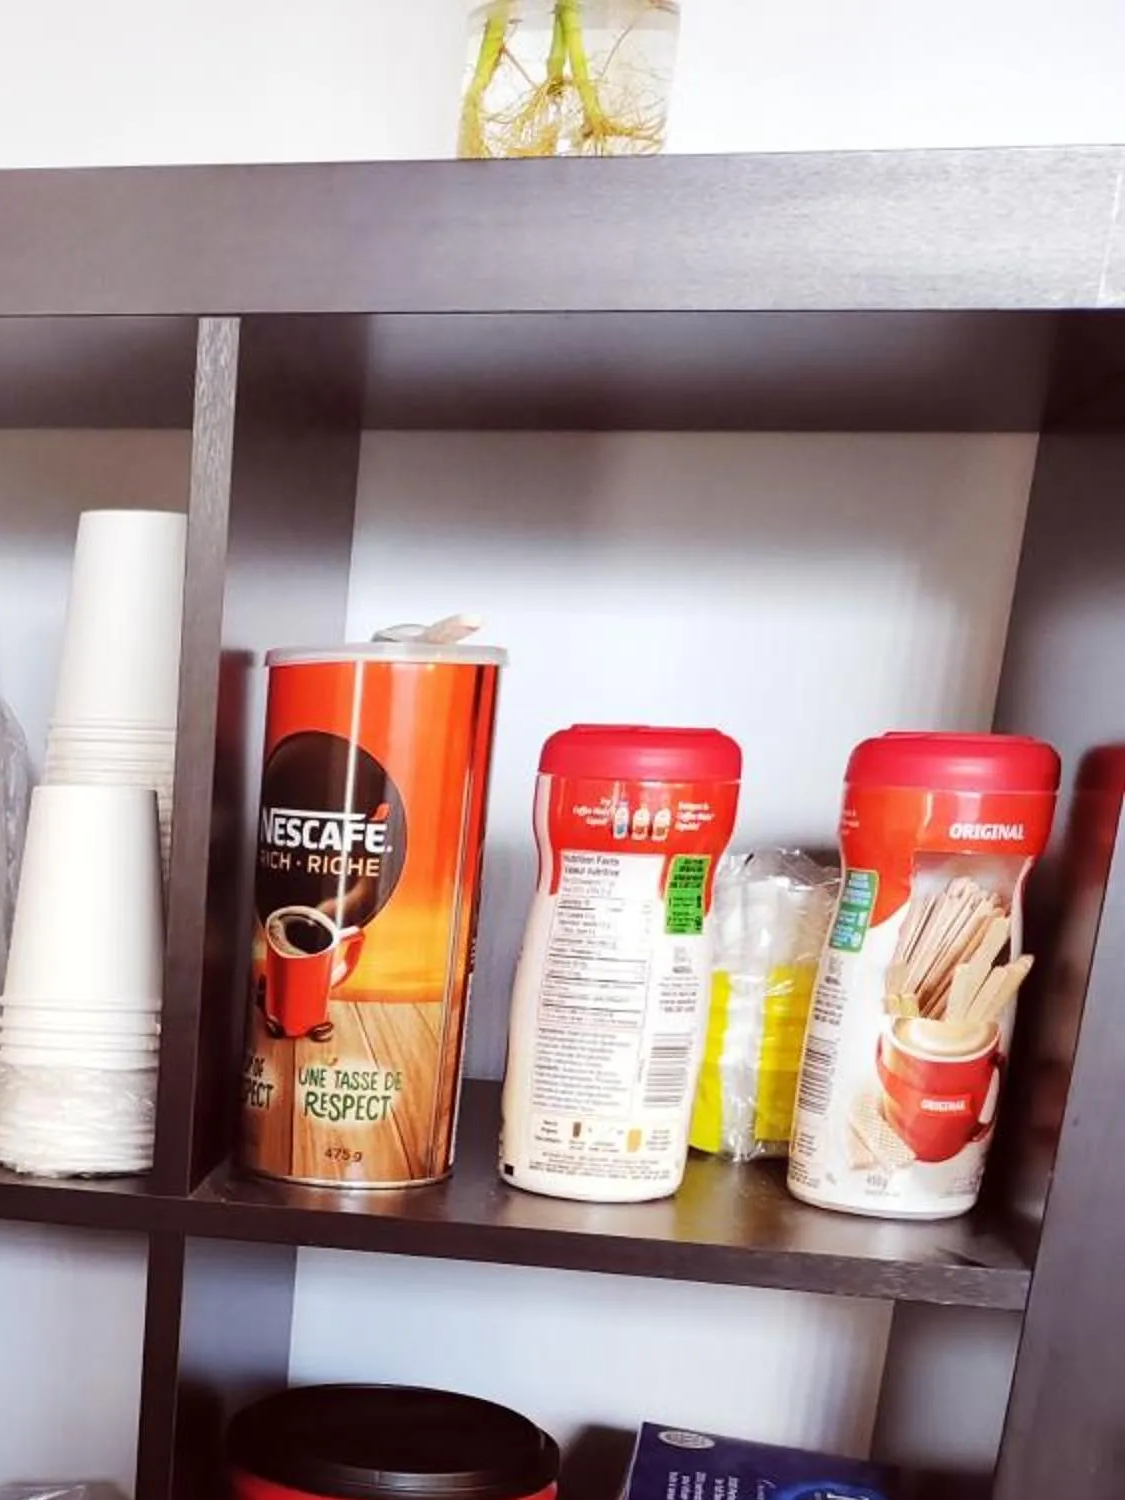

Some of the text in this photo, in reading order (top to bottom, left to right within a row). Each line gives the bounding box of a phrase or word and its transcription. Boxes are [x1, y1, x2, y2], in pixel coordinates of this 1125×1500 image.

[948, 823, 1024, 840] ORIGINAL
[307, 855, 380, 877] RICHE
[299, 1067, 402, 1091] UNE TASSE DE
[304, 1091, 392, 1121] RESPECT
